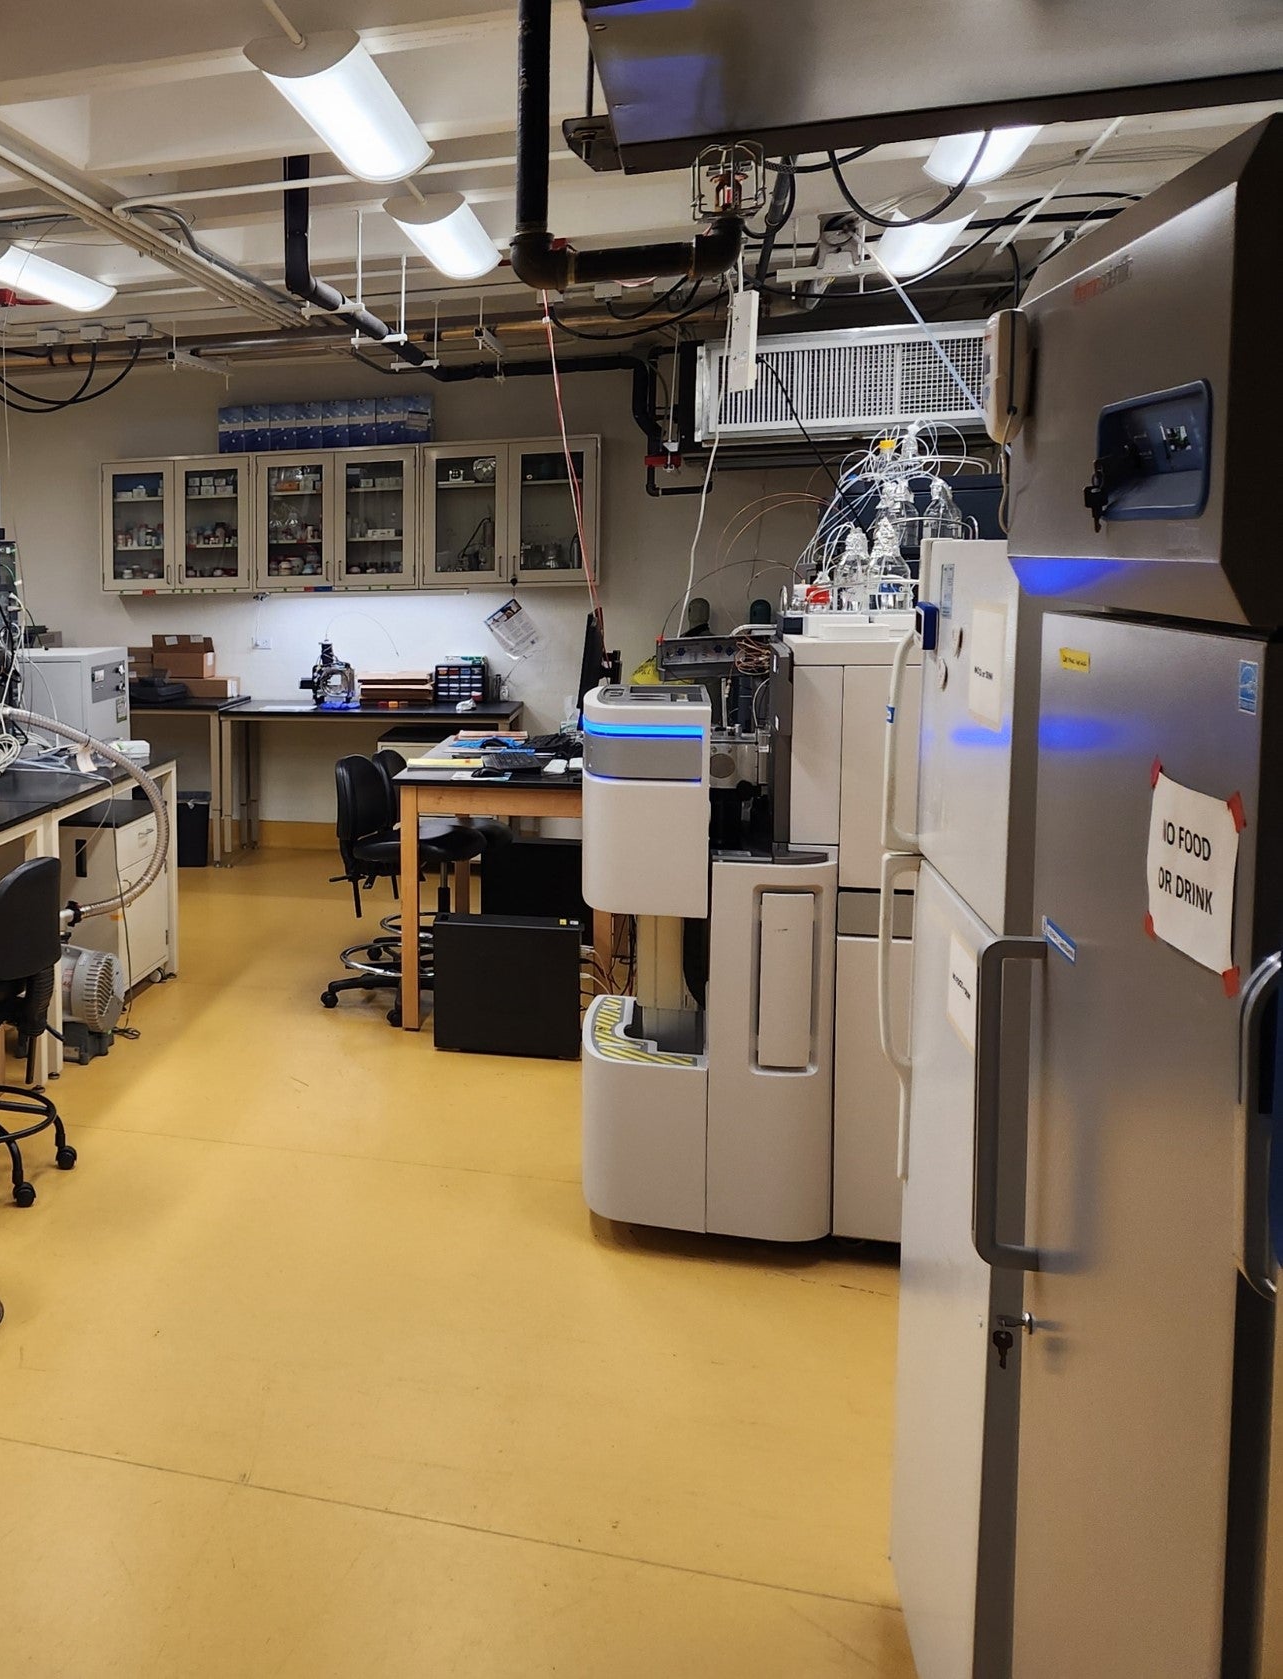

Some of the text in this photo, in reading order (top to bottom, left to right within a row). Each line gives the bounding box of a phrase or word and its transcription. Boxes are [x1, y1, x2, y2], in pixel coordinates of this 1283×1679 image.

[1179, 826, 1211, 861] FOOD
[1158, 866, 1213, 915] OR DRINK
